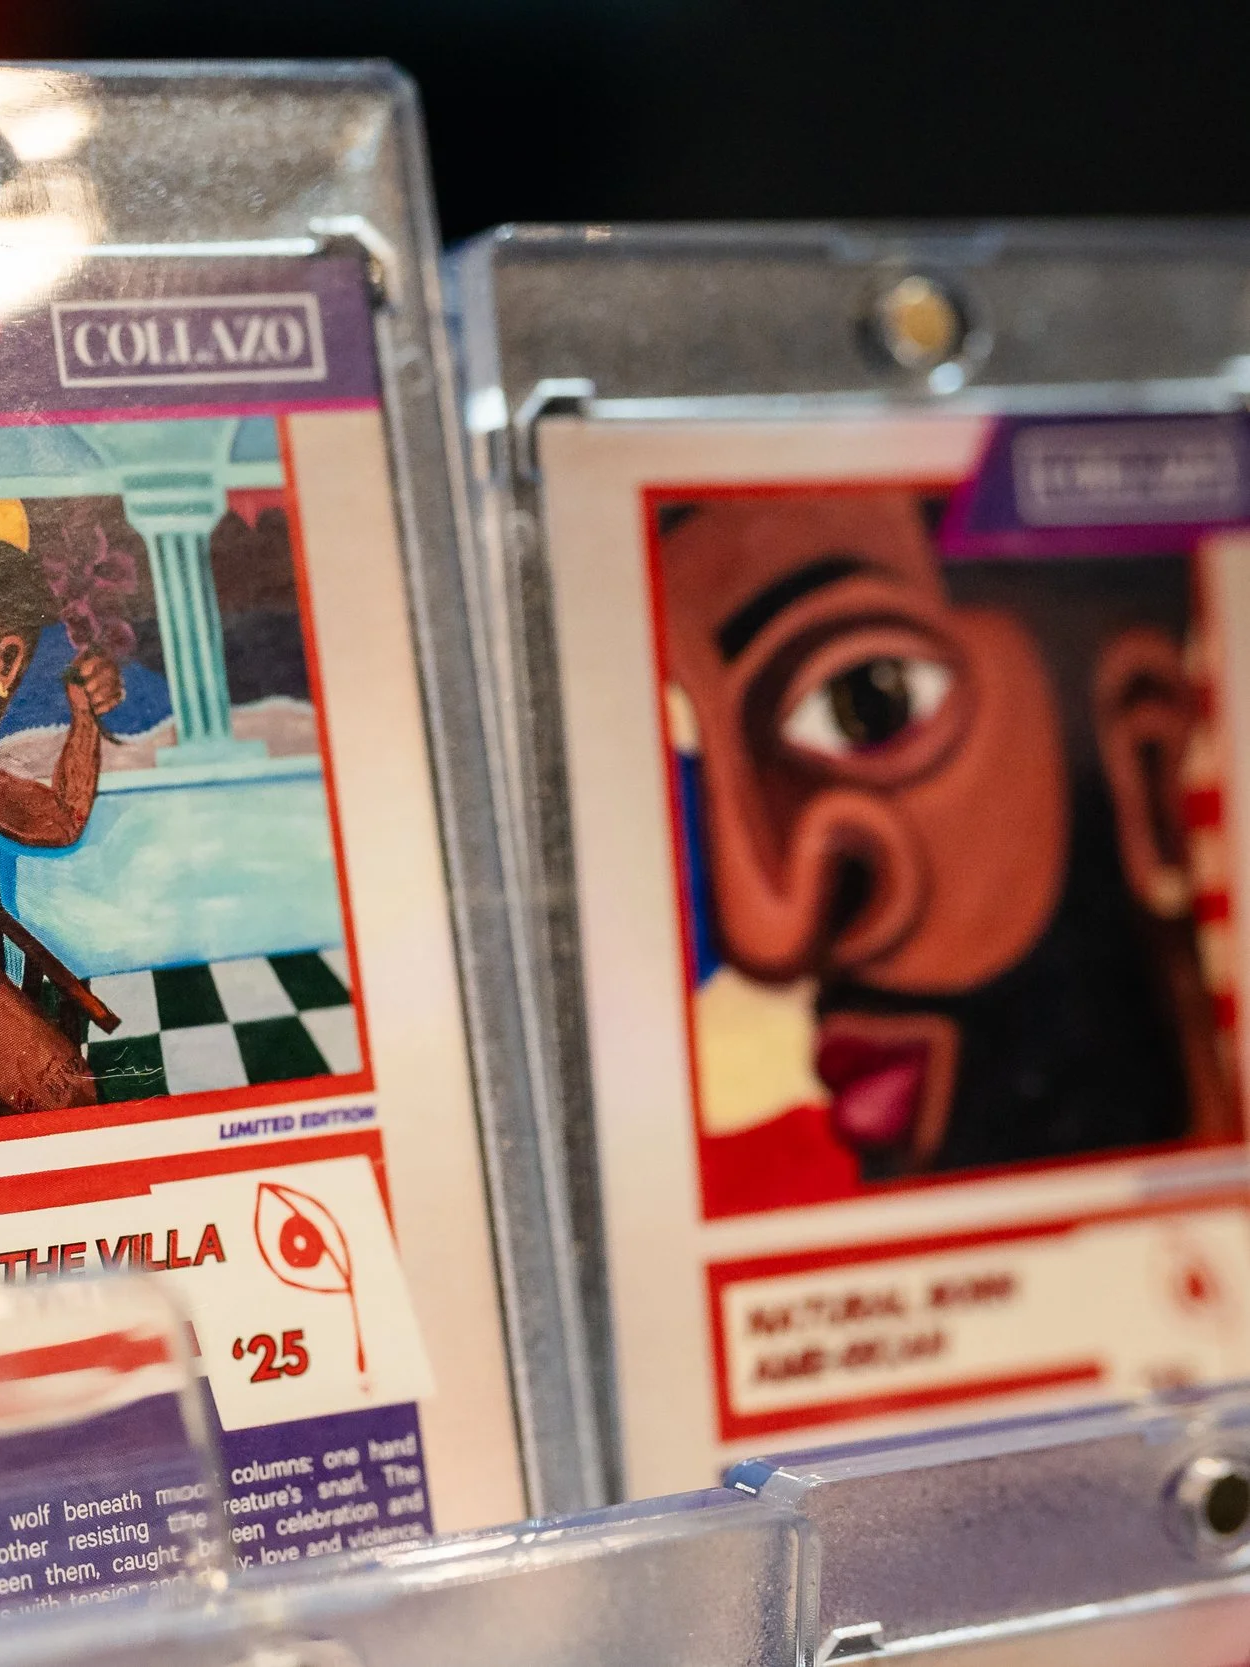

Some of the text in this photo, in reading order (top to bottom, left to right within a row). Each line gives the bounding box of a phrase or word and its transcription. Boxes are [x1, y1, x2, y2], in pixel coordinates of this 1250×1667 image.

[72, 313, 305, 368] COLLAZO
[220, 1105, 376, 1141] LIMITED EDITION
[95, 1223, 227, 1274] VILLA
[9, 1502, 51, 1532] wolf
[63, 1489, 142, 1522] beneath
[322, 1446, 361, 1470] one
[44, 1562, 101, 1587] them,
[112, 1545, 181, 1575] caught
[275, 1501, 379, 1537] celebration
[387, 1487, 424, 1517] and
[68, 1520, 150, 1551] resisting
[260, 1545, 300, 1566] love
[305, 1531, 343, 1558] and
